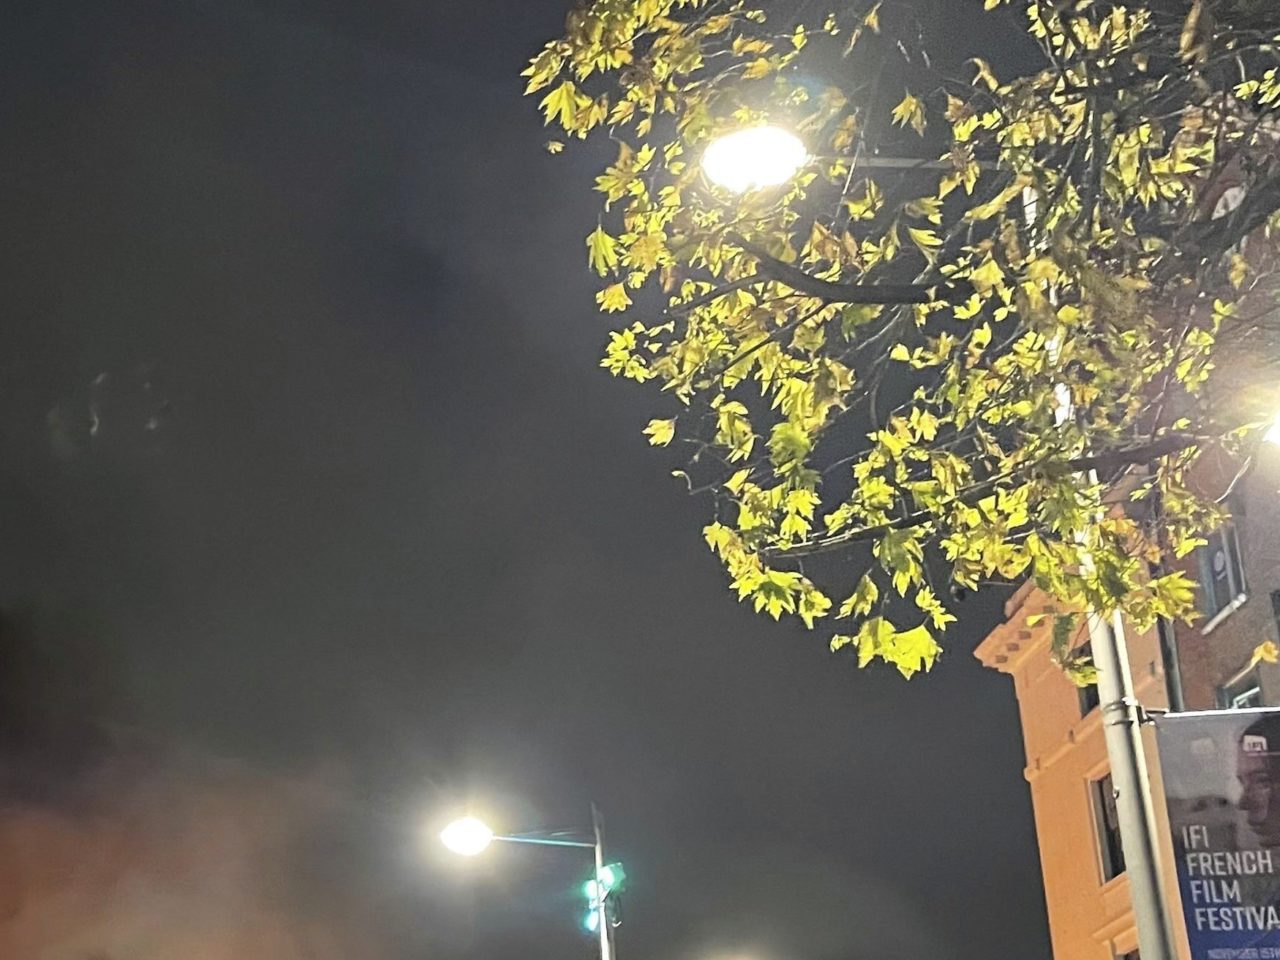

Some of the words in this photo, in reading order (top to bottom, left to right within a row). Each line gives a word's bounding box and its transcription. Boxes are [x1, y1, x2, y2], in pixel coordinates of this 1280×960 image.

[1182, 825, 1209, 849] IFI
[1186, 850, 1273, 876] FRENCH
[1190, 880, 1241, 904] FILM
[1194, 905, 1280, 931] FESTIVA
